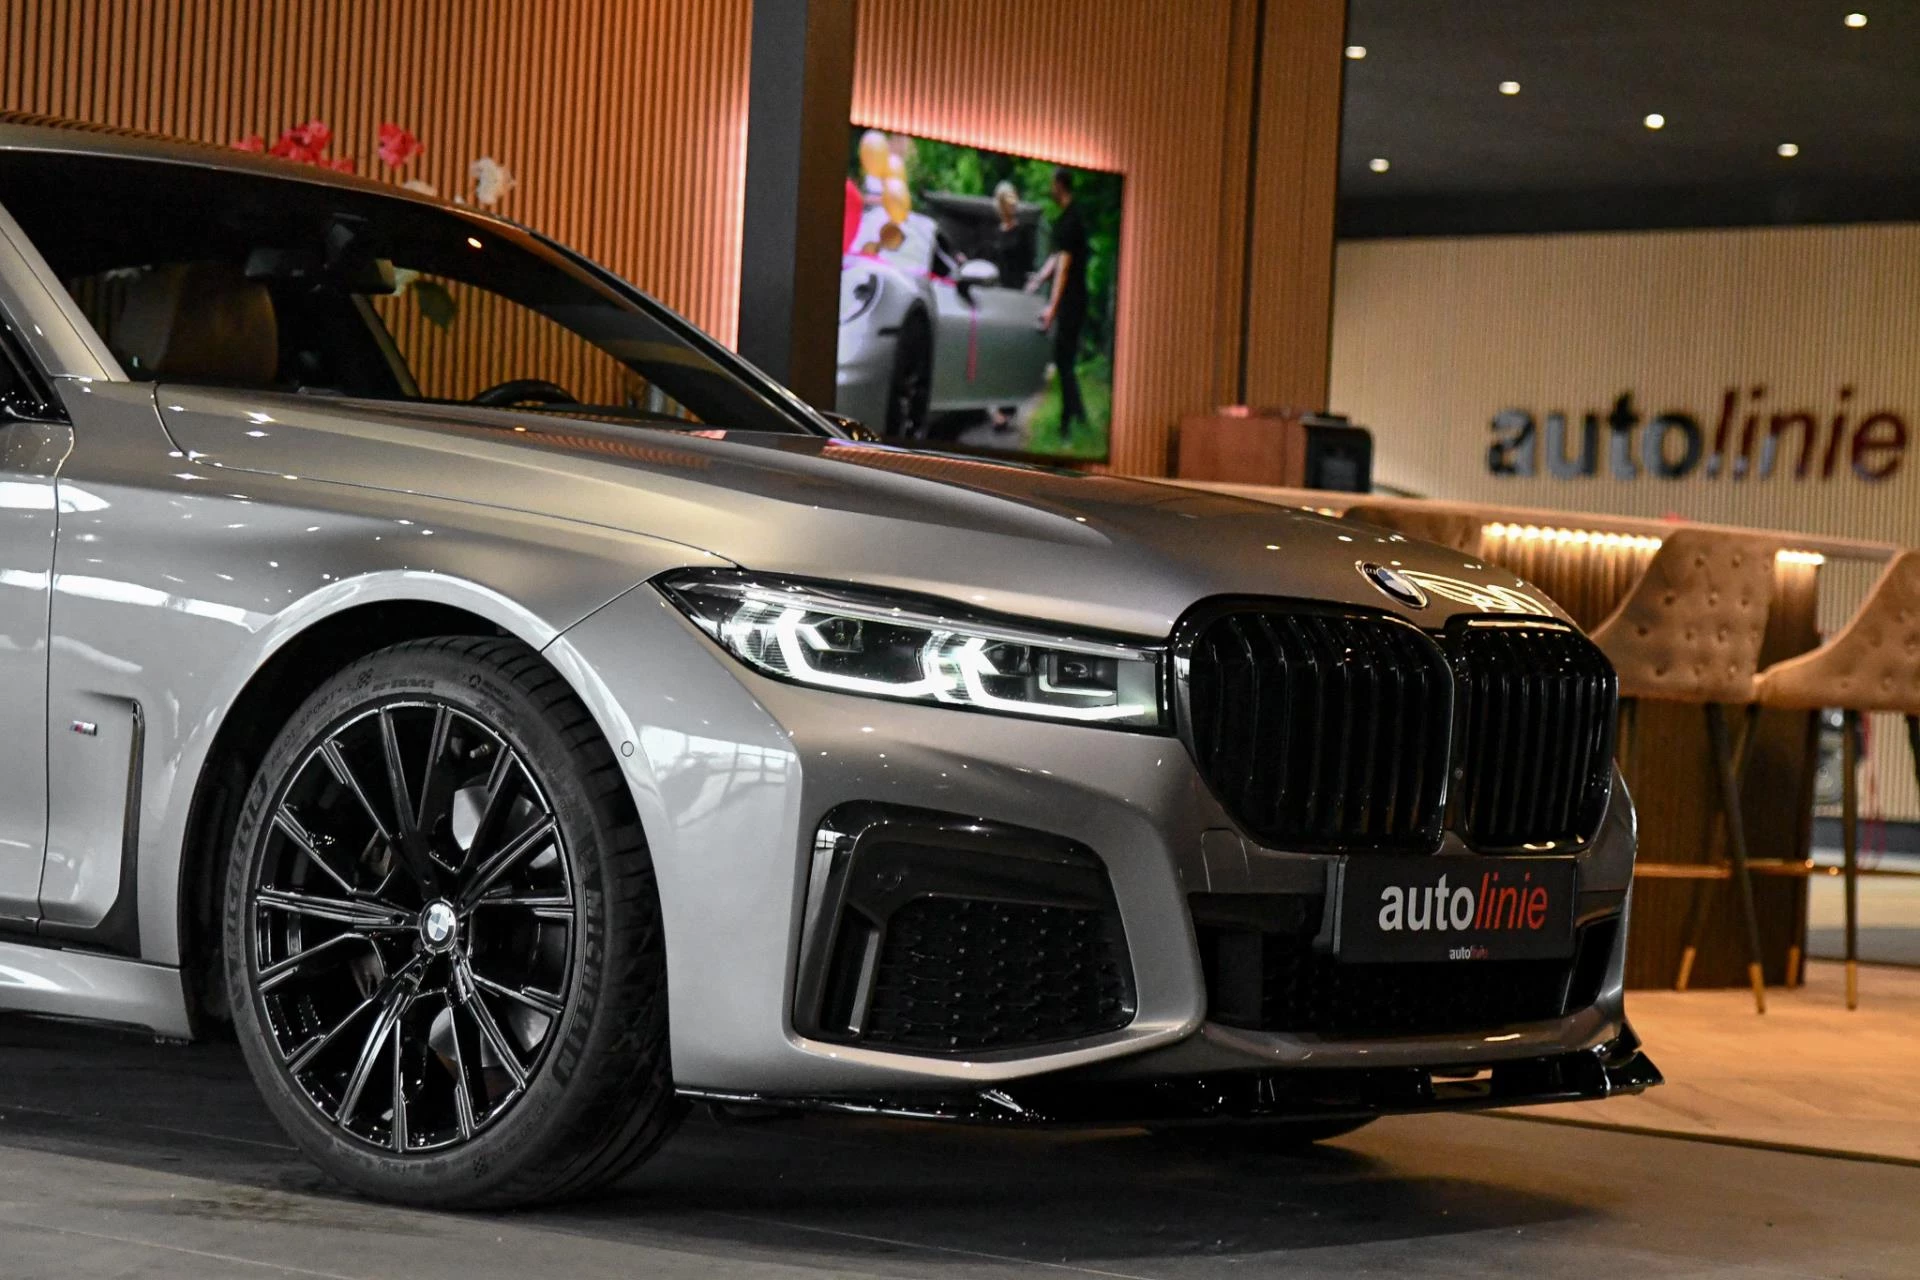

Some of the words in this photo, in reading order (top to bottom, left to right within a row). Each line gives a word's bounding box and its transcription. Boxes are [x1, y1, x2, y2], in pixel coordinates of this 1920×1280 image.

[1488, 384, 1906, 481] autolinie
[1378, 871, 1548, 931] autolinie
[557, 886, 602, 1078] MICHELIN
